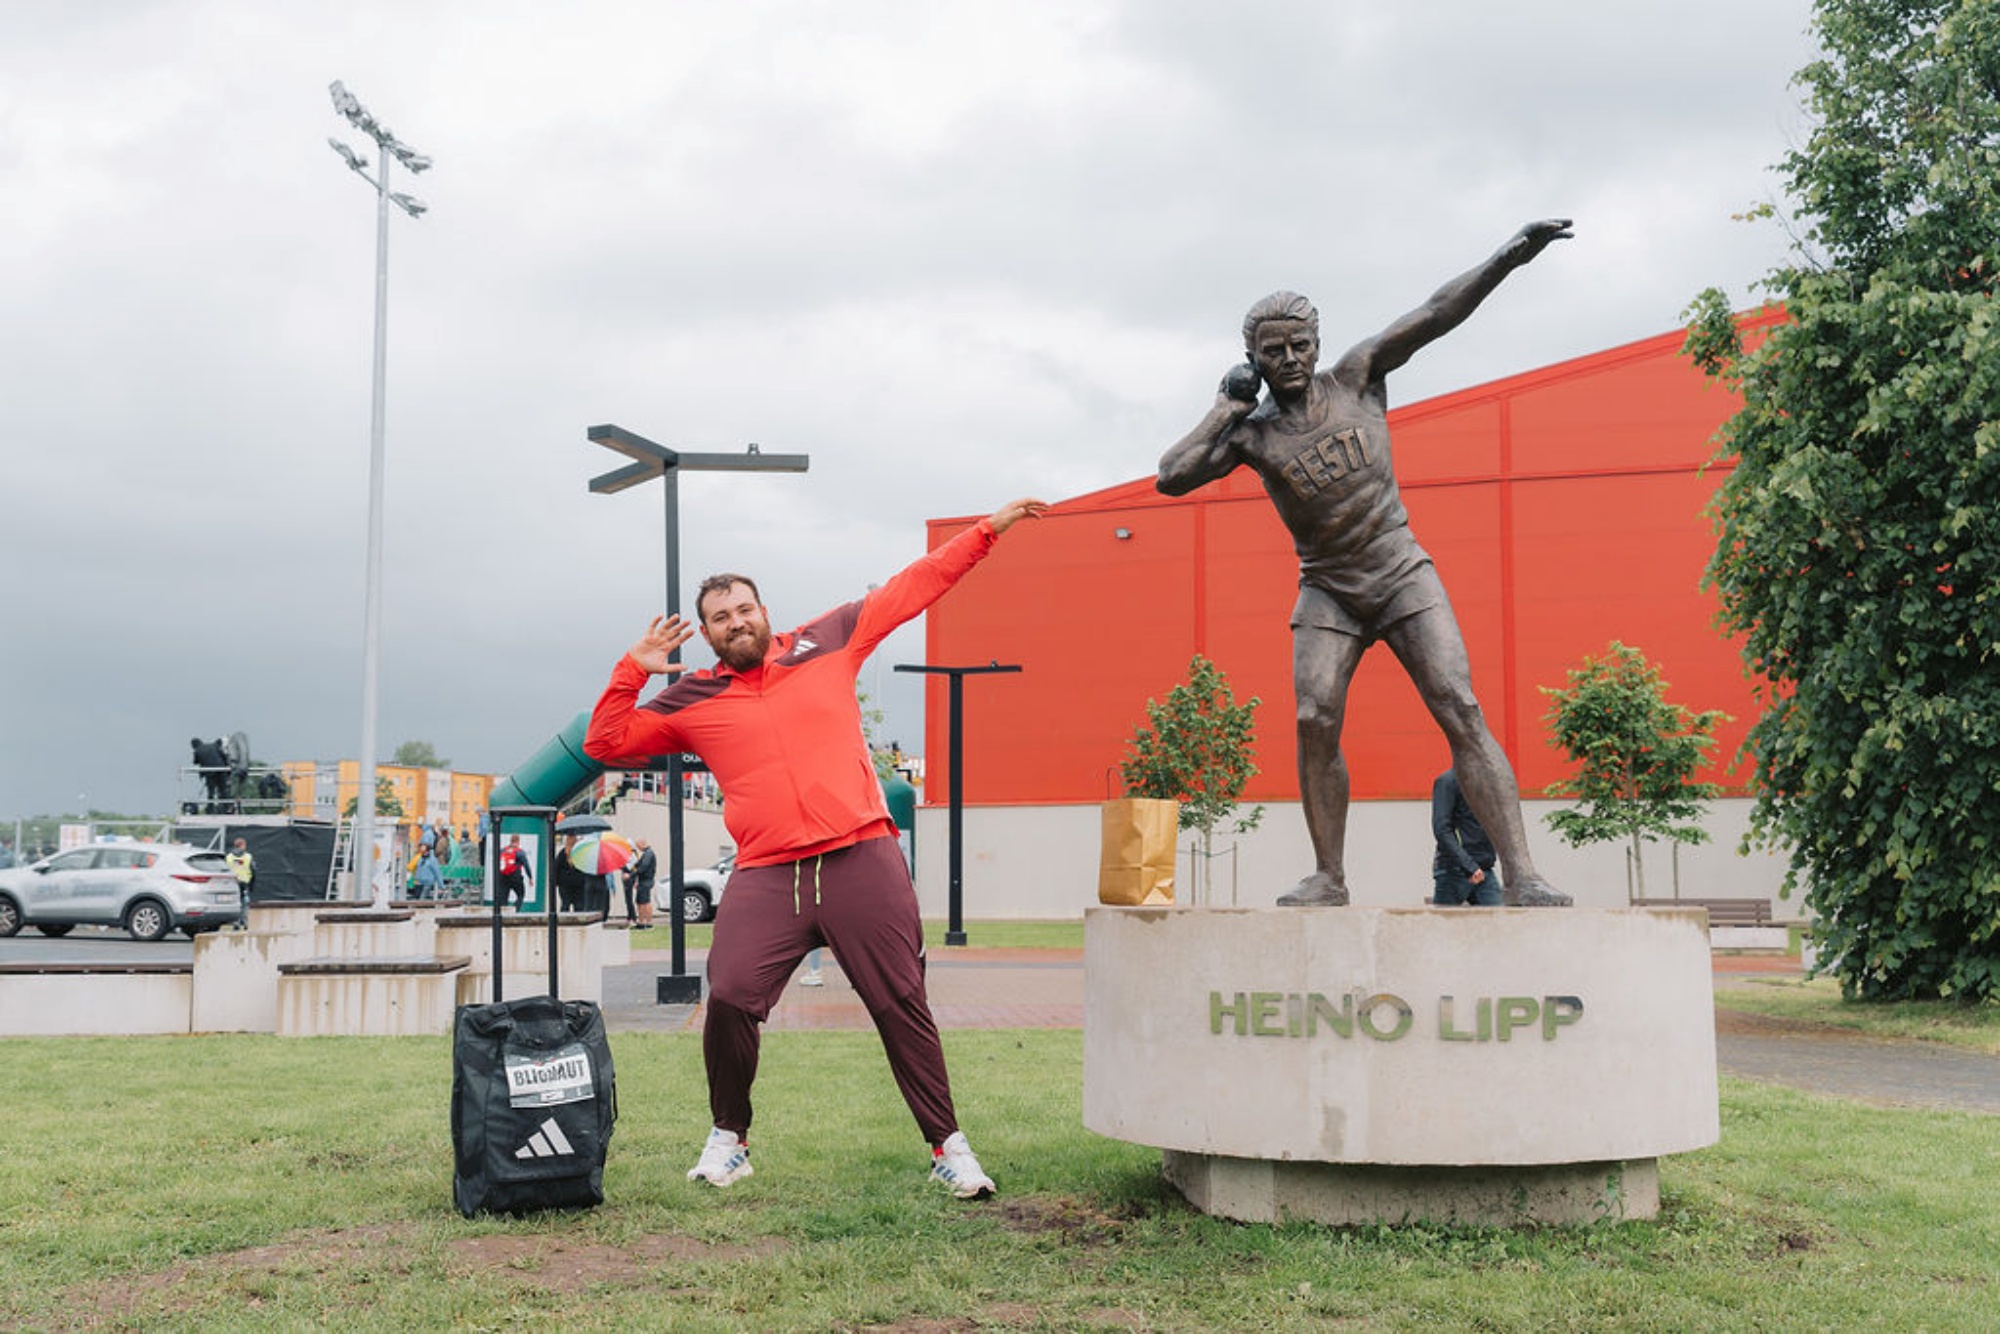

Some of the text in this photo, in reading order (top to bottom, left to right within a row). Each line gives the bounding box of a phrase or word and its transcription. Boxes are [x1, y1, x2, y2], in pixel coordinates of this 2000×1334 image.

[1281, 427, 1373, 500] EESTI
[1209, 991, 1584, 1042] HEINO LIPP
